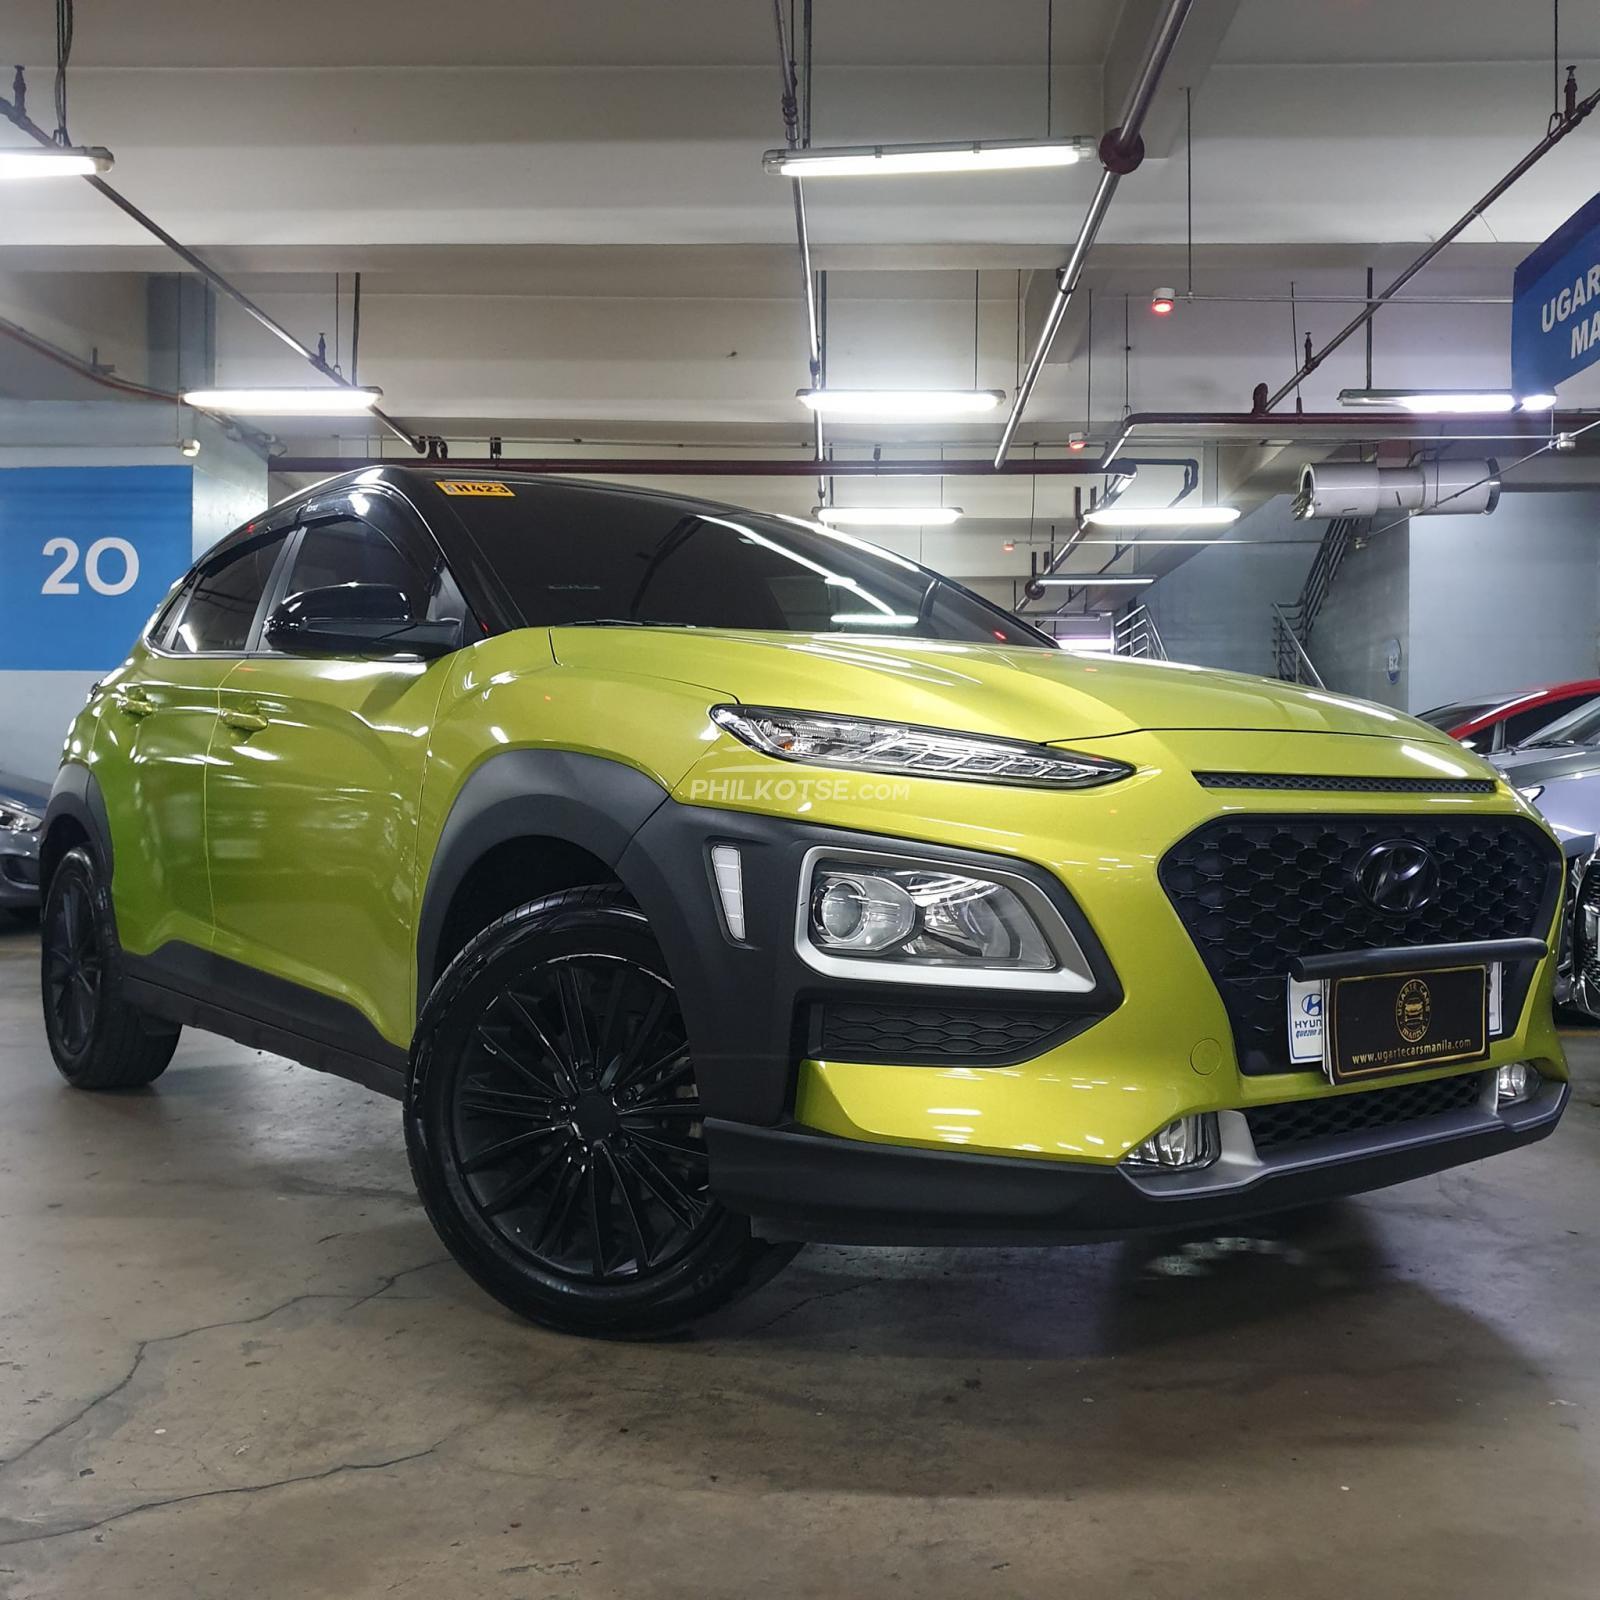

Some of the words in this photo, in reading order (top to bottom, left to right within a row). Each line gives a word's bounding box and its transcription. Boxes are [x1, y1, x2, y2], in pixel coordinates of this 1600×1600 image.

[1542, 266, 1600, 332] UGAR
[41, 537, 140, 596] 20
[1352, 1039, 1471, 1064] www.ugartecarsmanila.com
